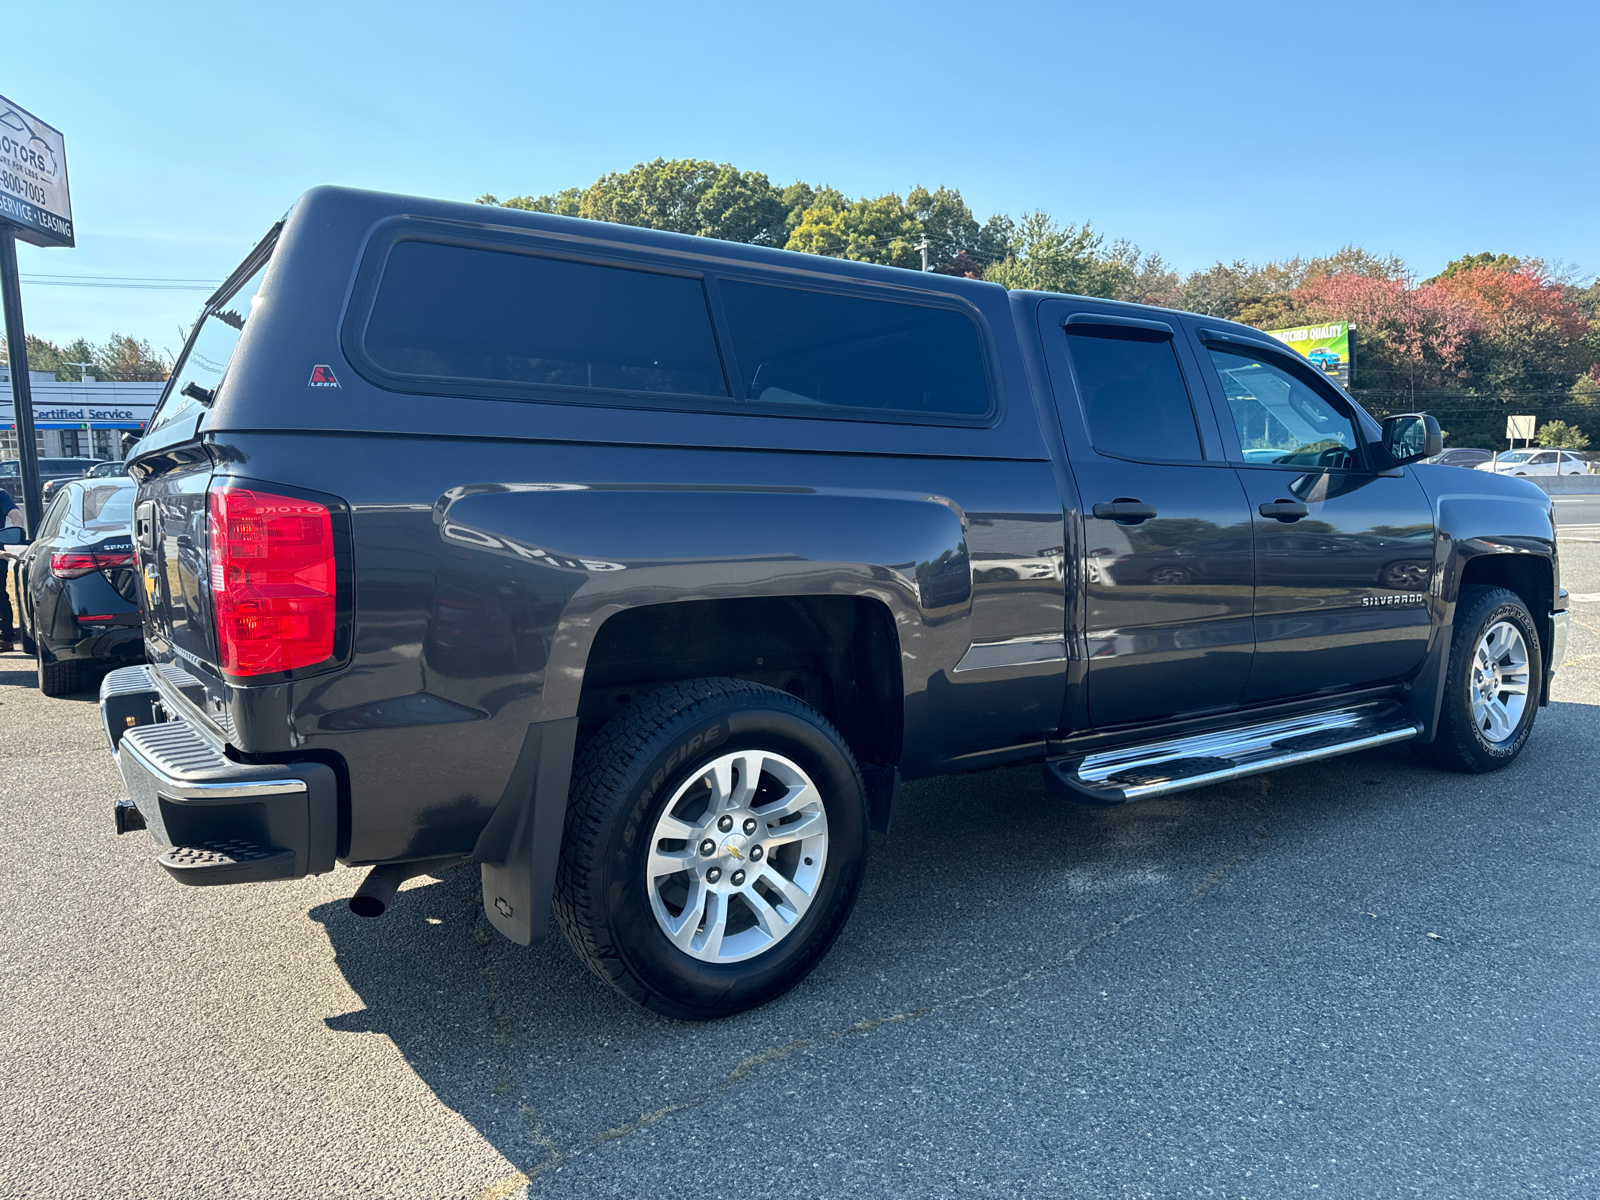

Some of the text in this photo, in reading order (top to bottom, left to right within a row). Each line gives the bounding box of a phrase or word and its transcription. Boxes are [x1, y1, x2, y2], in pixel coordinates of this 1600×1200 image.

[0, 136, 45, 172] OTORS
[12, 161, 23, 173] FOR
[25, 168, 38, 180] LESS
[38, 210, 71, 237] LEASING
[1309, 324, 1342, 340] QUALITY
[89, 409, 133, 419] Service
[1361, 593, 1423, 607] SILVERADO
[622, 724, 721, 845] STARFIRE
